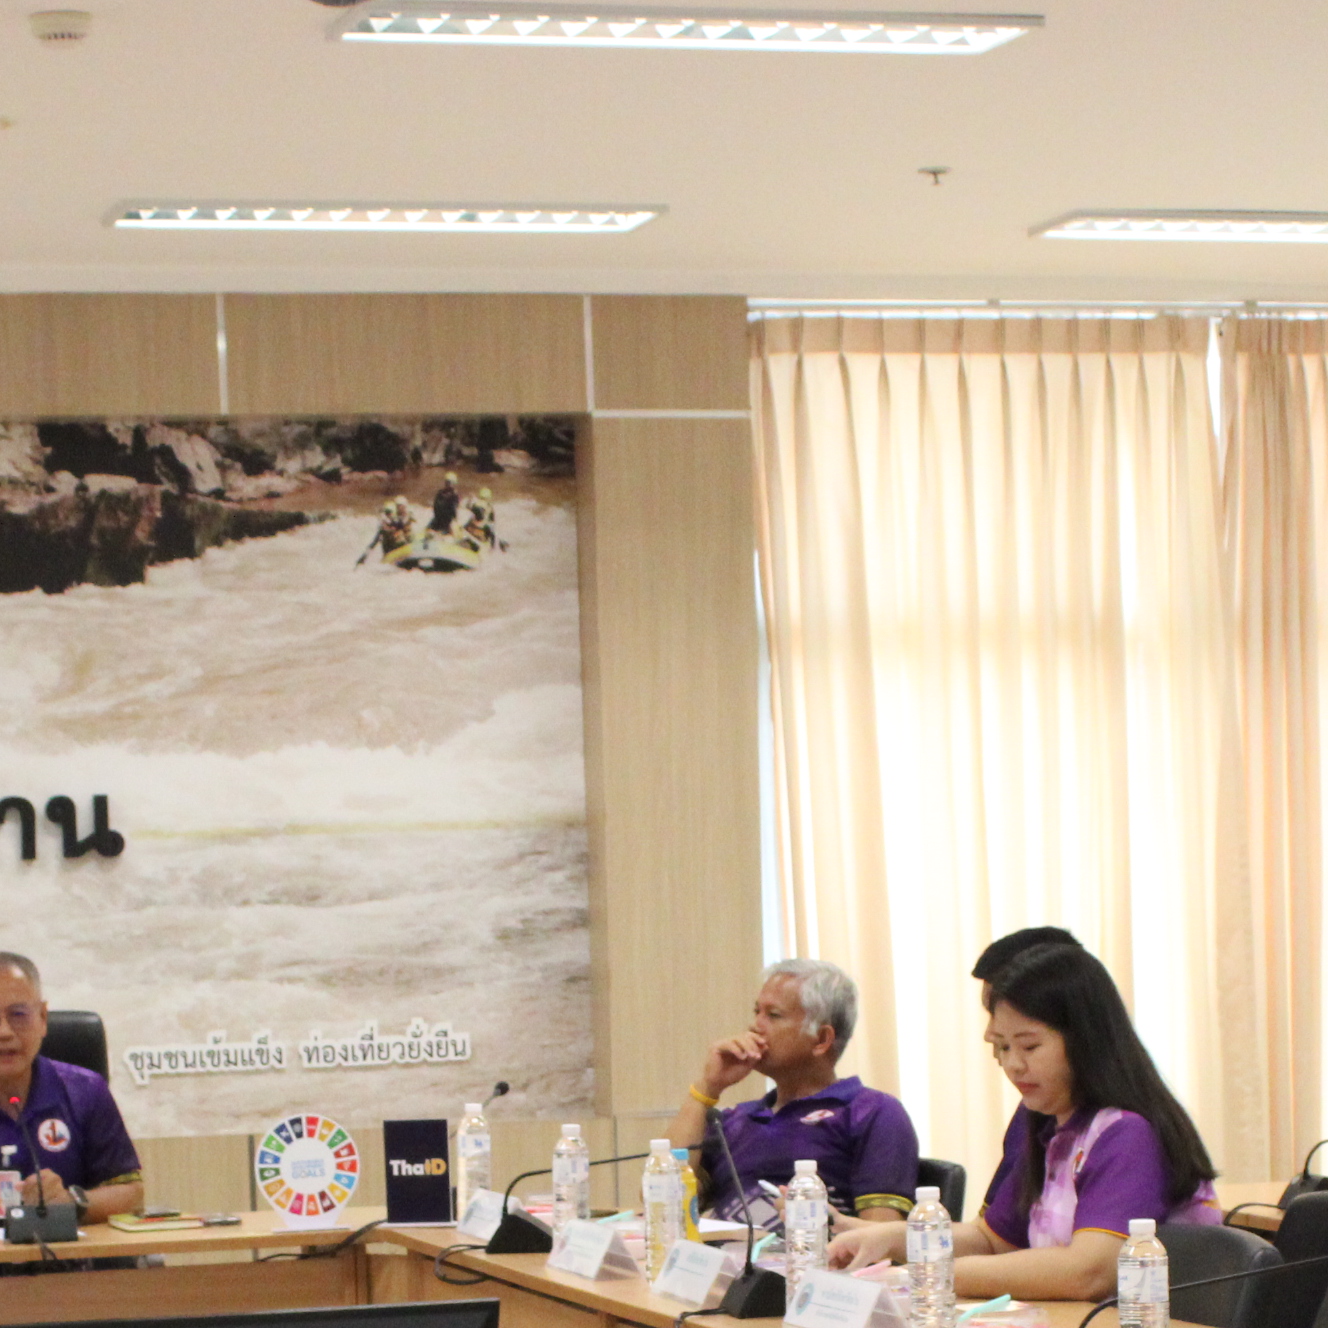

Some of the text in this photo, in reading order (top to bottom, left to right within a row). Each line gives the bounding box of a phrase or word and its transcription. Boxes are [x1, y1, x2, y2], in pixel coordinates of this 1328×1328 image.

[128, 1035, 284, 1079] ชุมชนเข้มแข็ง
[302, 1028, 468, 1065] ท่องเที่ยวยั่งยืน
